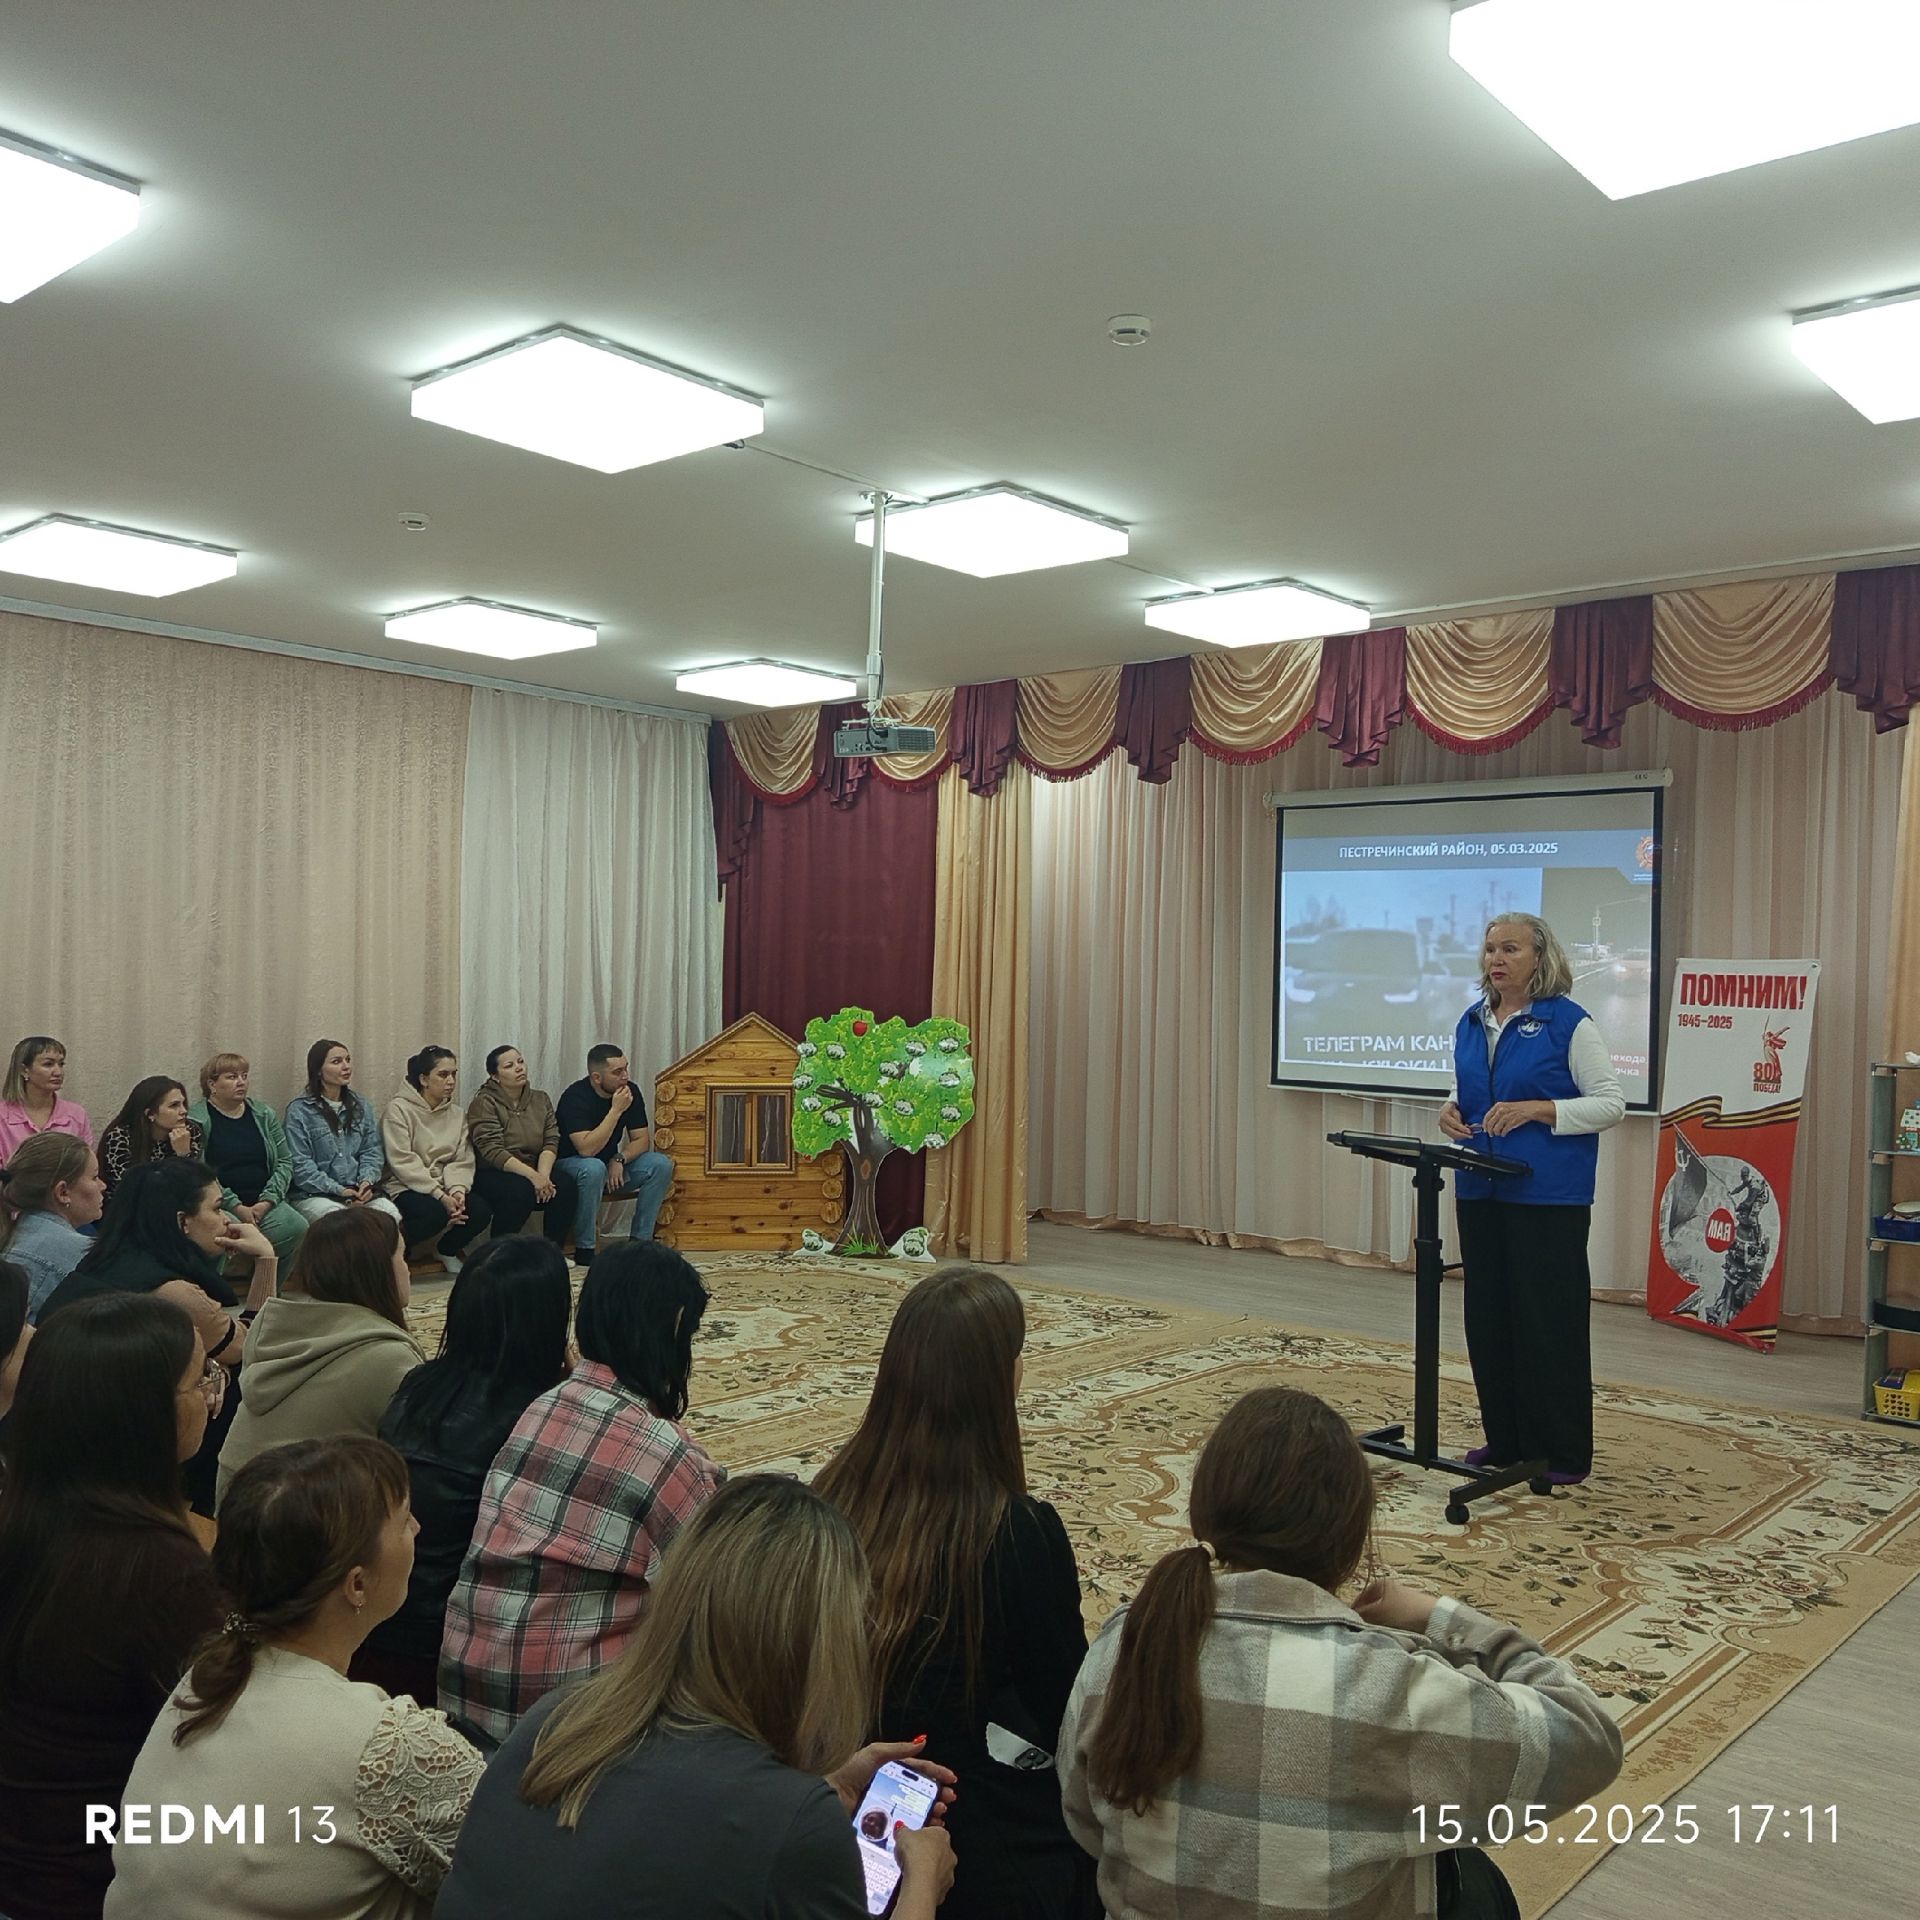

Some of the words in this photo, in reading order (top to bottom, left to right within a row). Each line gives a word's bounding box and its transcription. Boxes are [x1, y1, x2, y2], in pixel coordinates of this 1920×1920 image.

[1339, 843, 1438, 858] ПЕСТРЕЧИНСКИЙ
[1441, 842, 1488, 856] РАЙОН,
[1490, 842, 1558, 854] 05.03.2025
[1680, 973, 1807, 1010] ПОМНИМ!
[1303, 1035, 1405, 1052] ТЕЛЕГРАМ
[1410, 1035, 1455, 1052] КАН
[1611, 1054, 1646, 1064] ехода
[1707, 1219, 1732, 1242] МАЯ
